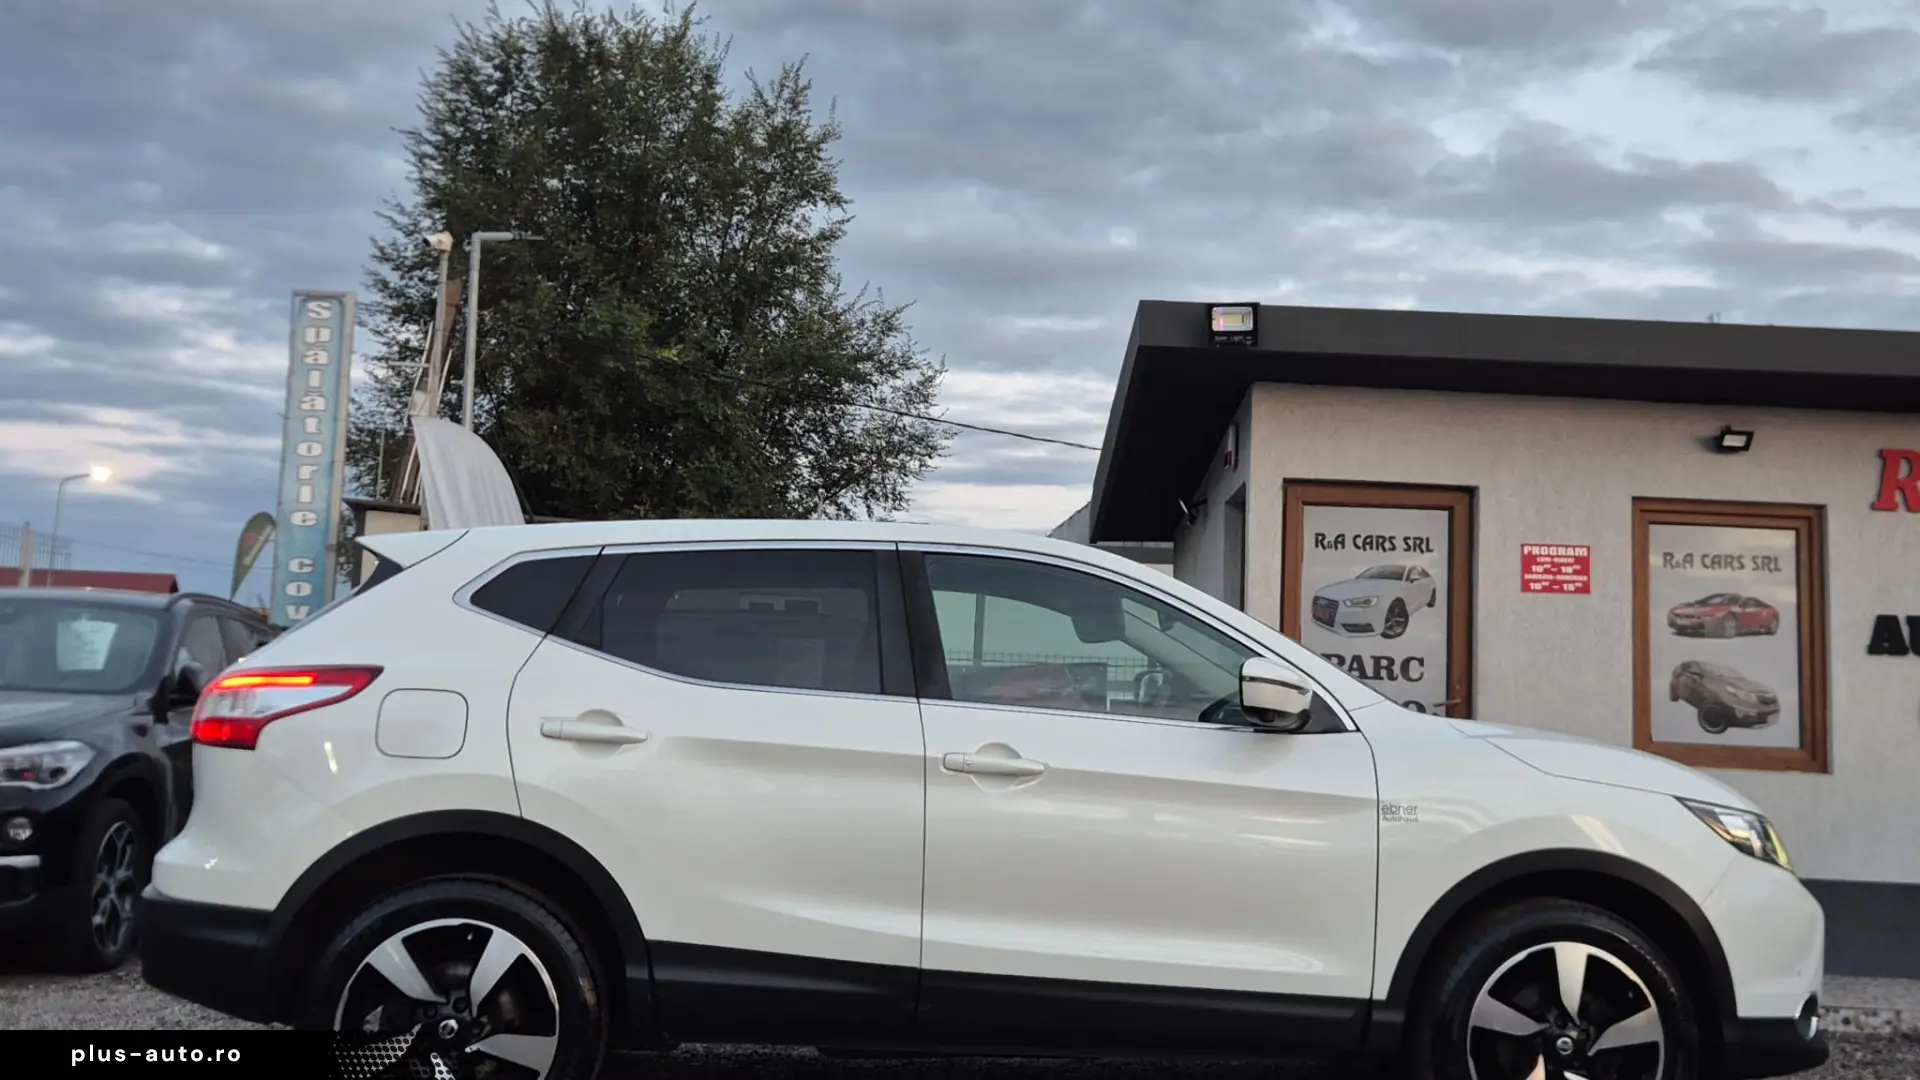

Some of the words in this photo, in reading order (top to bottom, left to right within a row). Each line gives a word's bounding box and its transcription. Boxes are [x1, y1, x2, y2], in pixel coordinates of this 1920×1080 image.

[1314, 532, 1346, 551] R&A
[1352, 534, 1397, 553] CARS
[1402, 536, 1434, 554] SRL
[1523, 545, 1588, 556] PROGRAM
[1662, 552, 1695, 570] R&A
[1701, 553, 1745, 572] CARS
[1751, 555, 1782, 574] SRL
